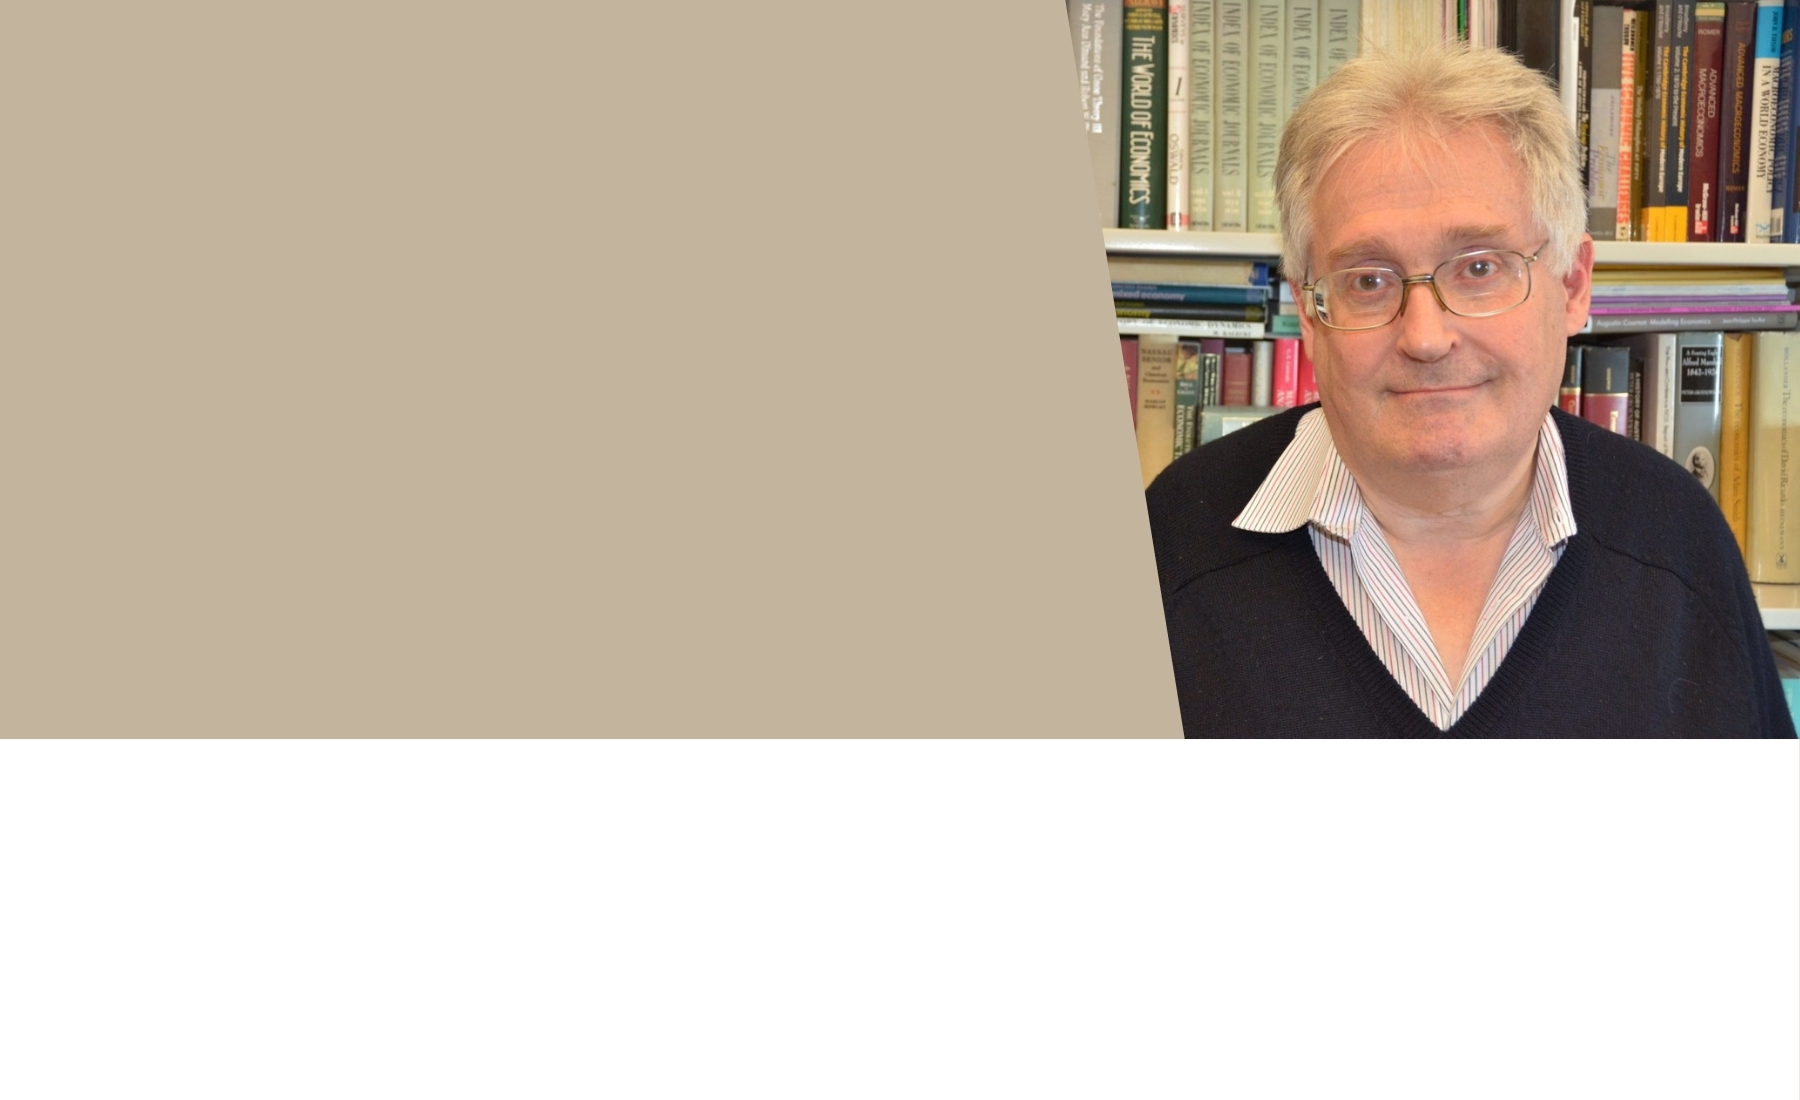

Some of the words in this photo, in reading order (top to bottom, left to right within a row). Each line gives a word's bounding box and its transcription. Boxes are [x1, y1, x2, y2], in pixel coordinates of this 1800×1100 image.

[1191, 1, 1211, 36] INDEX
[1222, 2, 1241, 37] INDEX
[1259, 5, 1279, 40] INDEX
[1293, 7, 1312, 42] INDEX
[1328, 8, 1349, 43] INDEX
[1131, 35, 1156, 61] THE
[1191, 40, 1211, 55] OF
[1222, 41, 1241, 56] OF
[1259, 44, 1278, 59] OF
[1292, 46, 1312, 61] OF
[1662, 46, 1670, 57] The
[1621, 53, 1636, 81] FIVE
[1660, 58, 1669, 90] Cambridge
[1680, 58, 1688, 90] Cambridge
[1735, 42, 1746, 89] ADVANCED
[1762, 65, 1772, 77] IN
[1130, 63, 1155, 110] WORLD
[1191, 58, 1211, 115] ECONOMIC
[1221, 60, 1241, 117] ECONOMIC
[1257, 62, 1278, 118] ECONOMIC
[1708, 68, 1718, 118] ADVANCED
[1761, 79, 1770, 87] A
[1619, 83, 1635, 147] ECONOMIC
[1660, 91, 1669, 119] Economic
[1680, 91, 1688, 119] Economic
[1695, 68, 1708, 158] MACROECONOMICS
[1759, 91, 1770, 127] WORLD
[1767, 65, 1780, 156] MACROECONOMIC
[1130, 111, 1152, 130] OF
[1732, 91, 1744, 174] MACROECONOMICS
[1169, 133, 1180, 186] OSWALD
[1190, 119, 1210, 176] JOURNALS
[1221, 120, 1241, 177] JOURNALS
[1256, 121, 1277, 179] JOURNALS
[1659, 149, 1667, 171] Modern
[1660, 141, 1667, 149] of
[1678, 149, 1686, 171] Modern
[1679, 141, 1685, 149] of
[1757, 130, 1769, 180] ECONOMY
[1129, 131, 1154, 205] ECONOMICS
[1676, 172, 1684, 193] Europe
[1766, 160, 1776, 195] POLICY
[1616, 151, 1632, 224] CHALLENGES
[1140, 291, 1185, 301] economy
[1596, 319, 1622, 328] Augustin
[1650, 317, 1679, 327] Modelling
[1680, 317, 1711, 326] Economics
[1682, 357, 1699, 366] Alfred
[1781, 390, 1791, 407] The
[1174, 404, 1185, 451] ECONOMIC
[1634, 409, 1640, 419] OF
[1733, 463, 1742, 473] of
[1780, 455, 1789, 477] David
[1733, 475, 1742, 498] Adam
[1780, 477, 1789, 506] Ricardo
[1732, 500, 1741, 523] Smith
